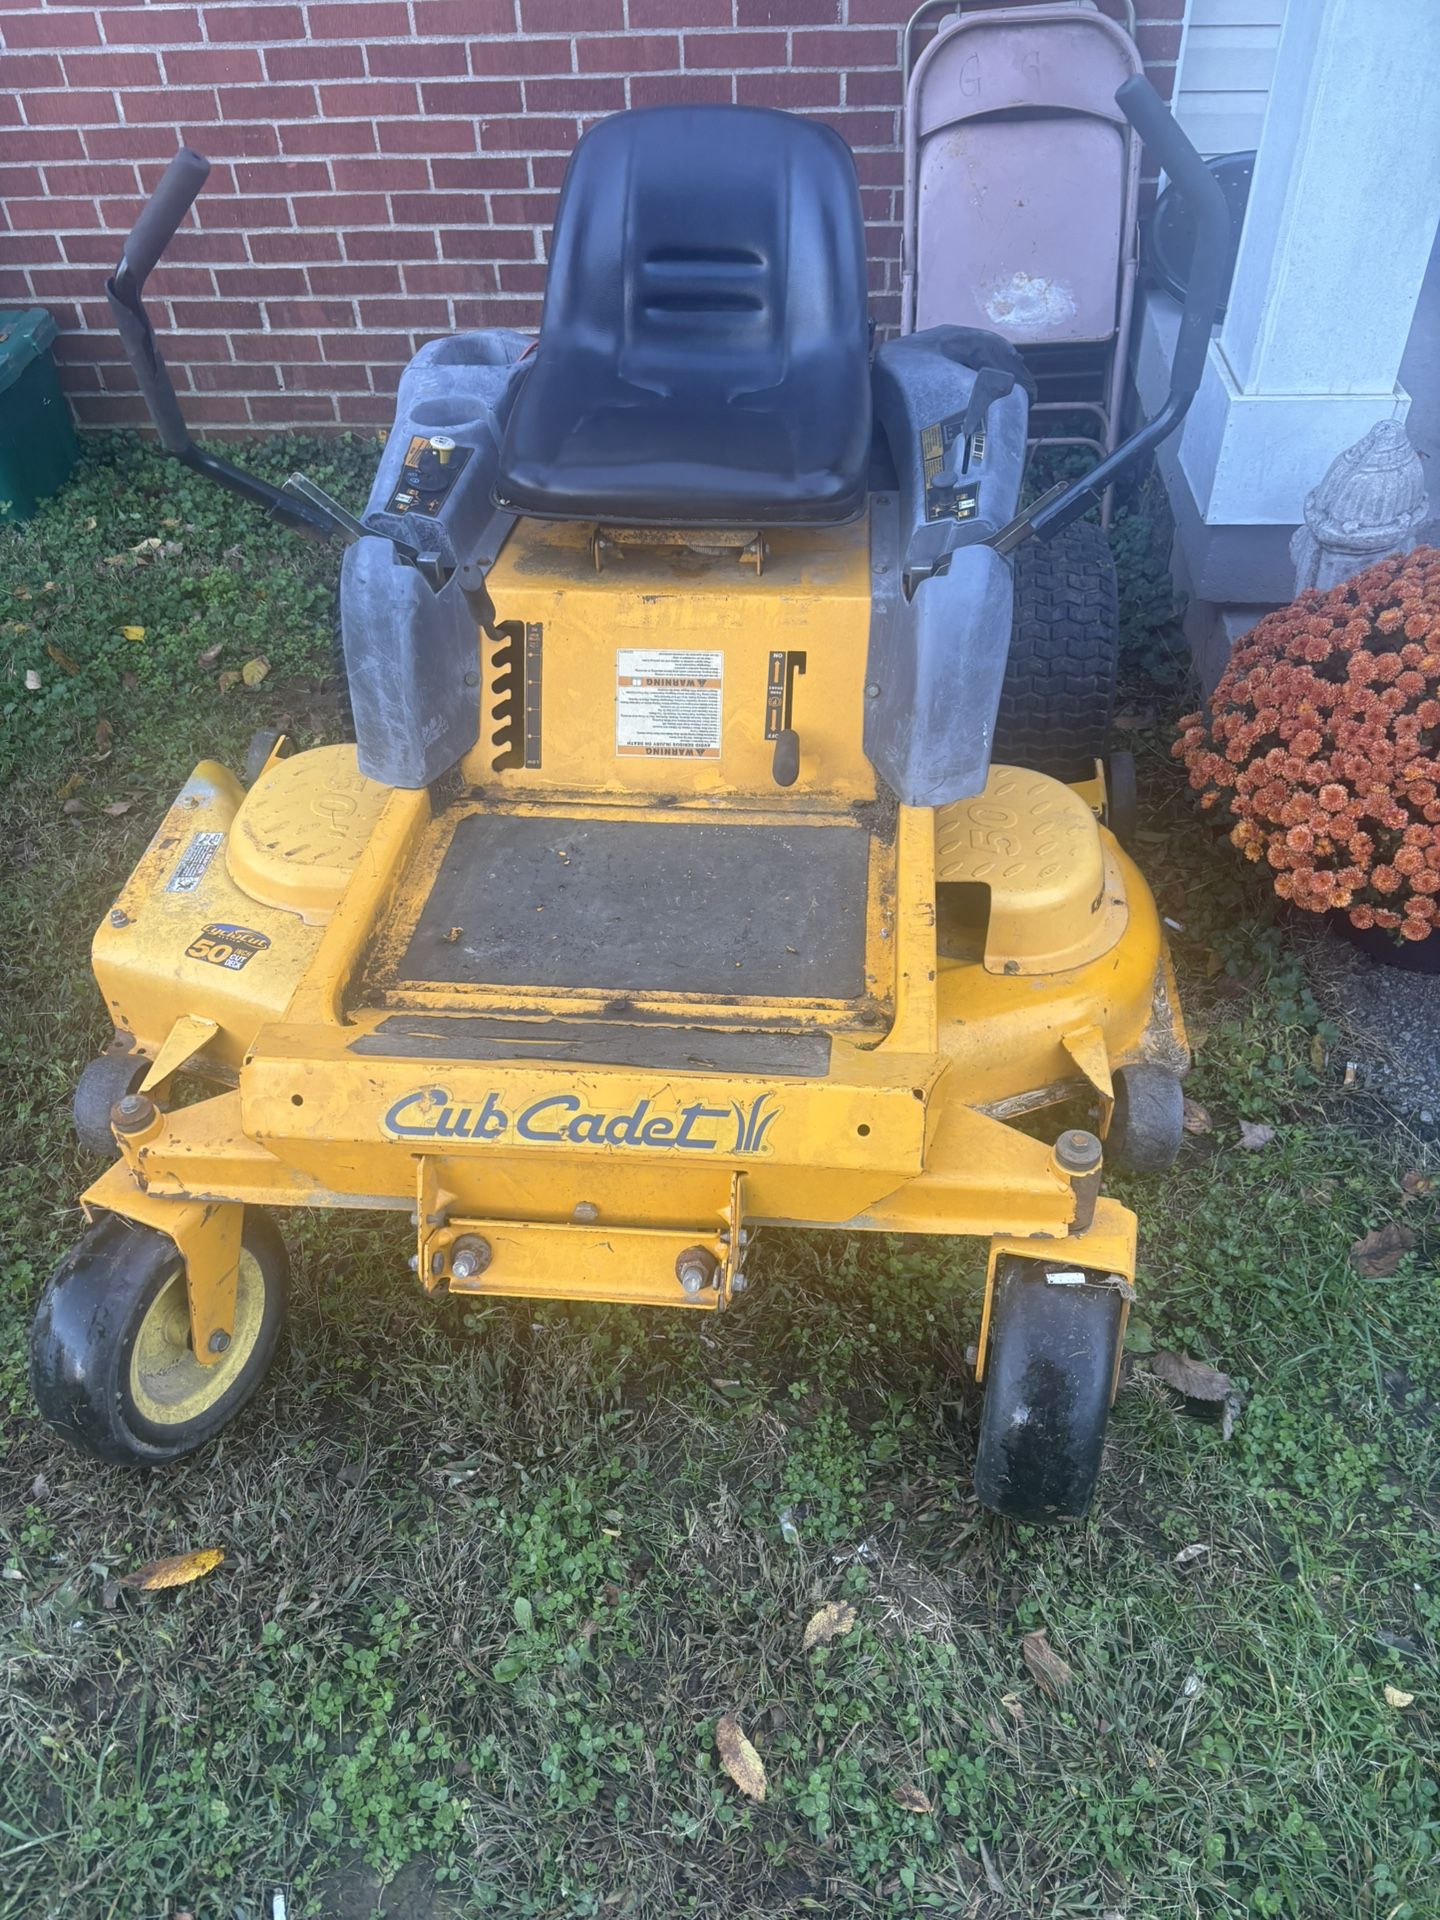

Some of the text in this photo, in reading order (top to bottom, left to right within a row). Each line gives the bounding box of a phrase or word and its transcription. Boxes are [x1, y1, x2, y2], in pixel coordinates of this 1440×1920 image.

[959, 51, 982, 97] G
[646, 678, 695, 687] WARNING
[645, 747, 694, 756] WARNING
[967, 803, 1021, 857] 50
[187, 938, 233, 963] 50
[229, 953, 248, 962] CUT
[223, 959, 244, 969] DECK
[384, 1088, 732, 1150] Cub Cadet
